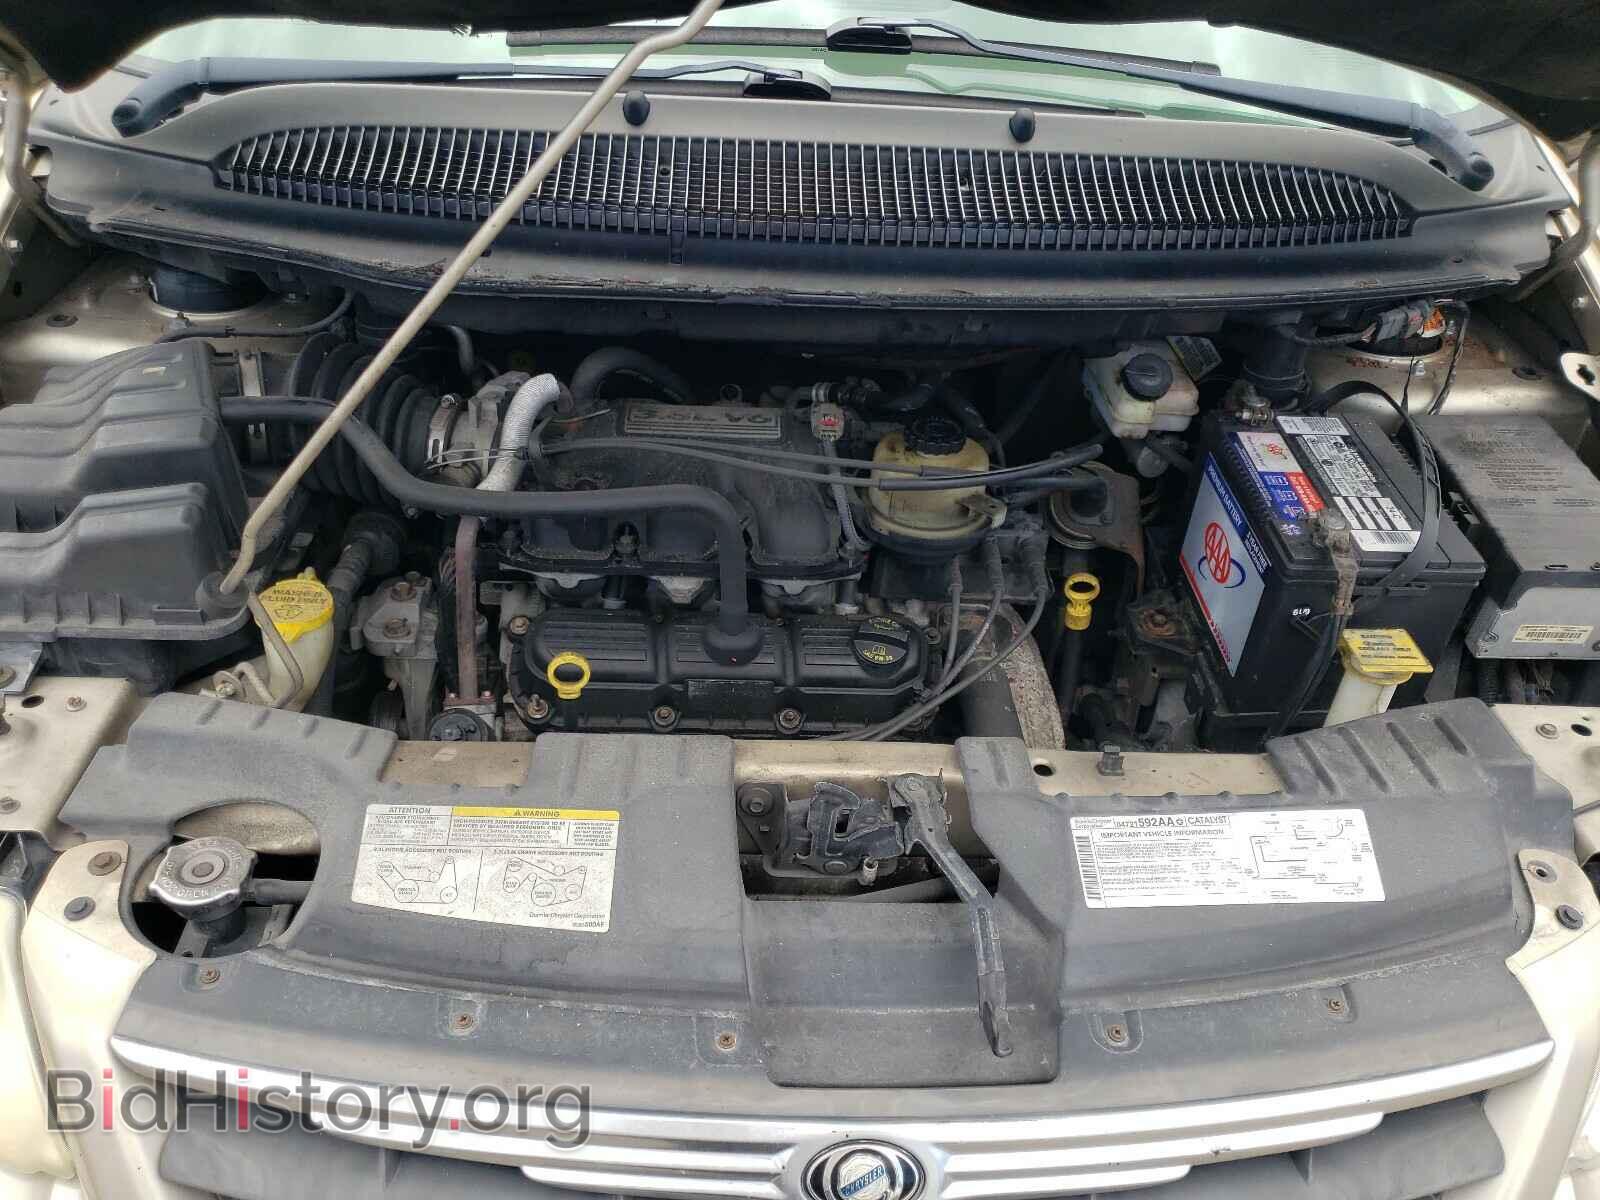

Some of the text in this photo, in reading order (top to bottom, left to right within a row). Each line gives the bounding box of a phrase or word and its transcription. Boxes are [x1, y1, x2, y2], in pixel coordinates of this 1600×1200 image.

[1223, 495, 1242, 527] BATTERY
[522, 810, 560, 818] WARNING
[1188, 815, 1228, 825] CATALYST
[844, 1165, 883, 1197] CHRYSLER
